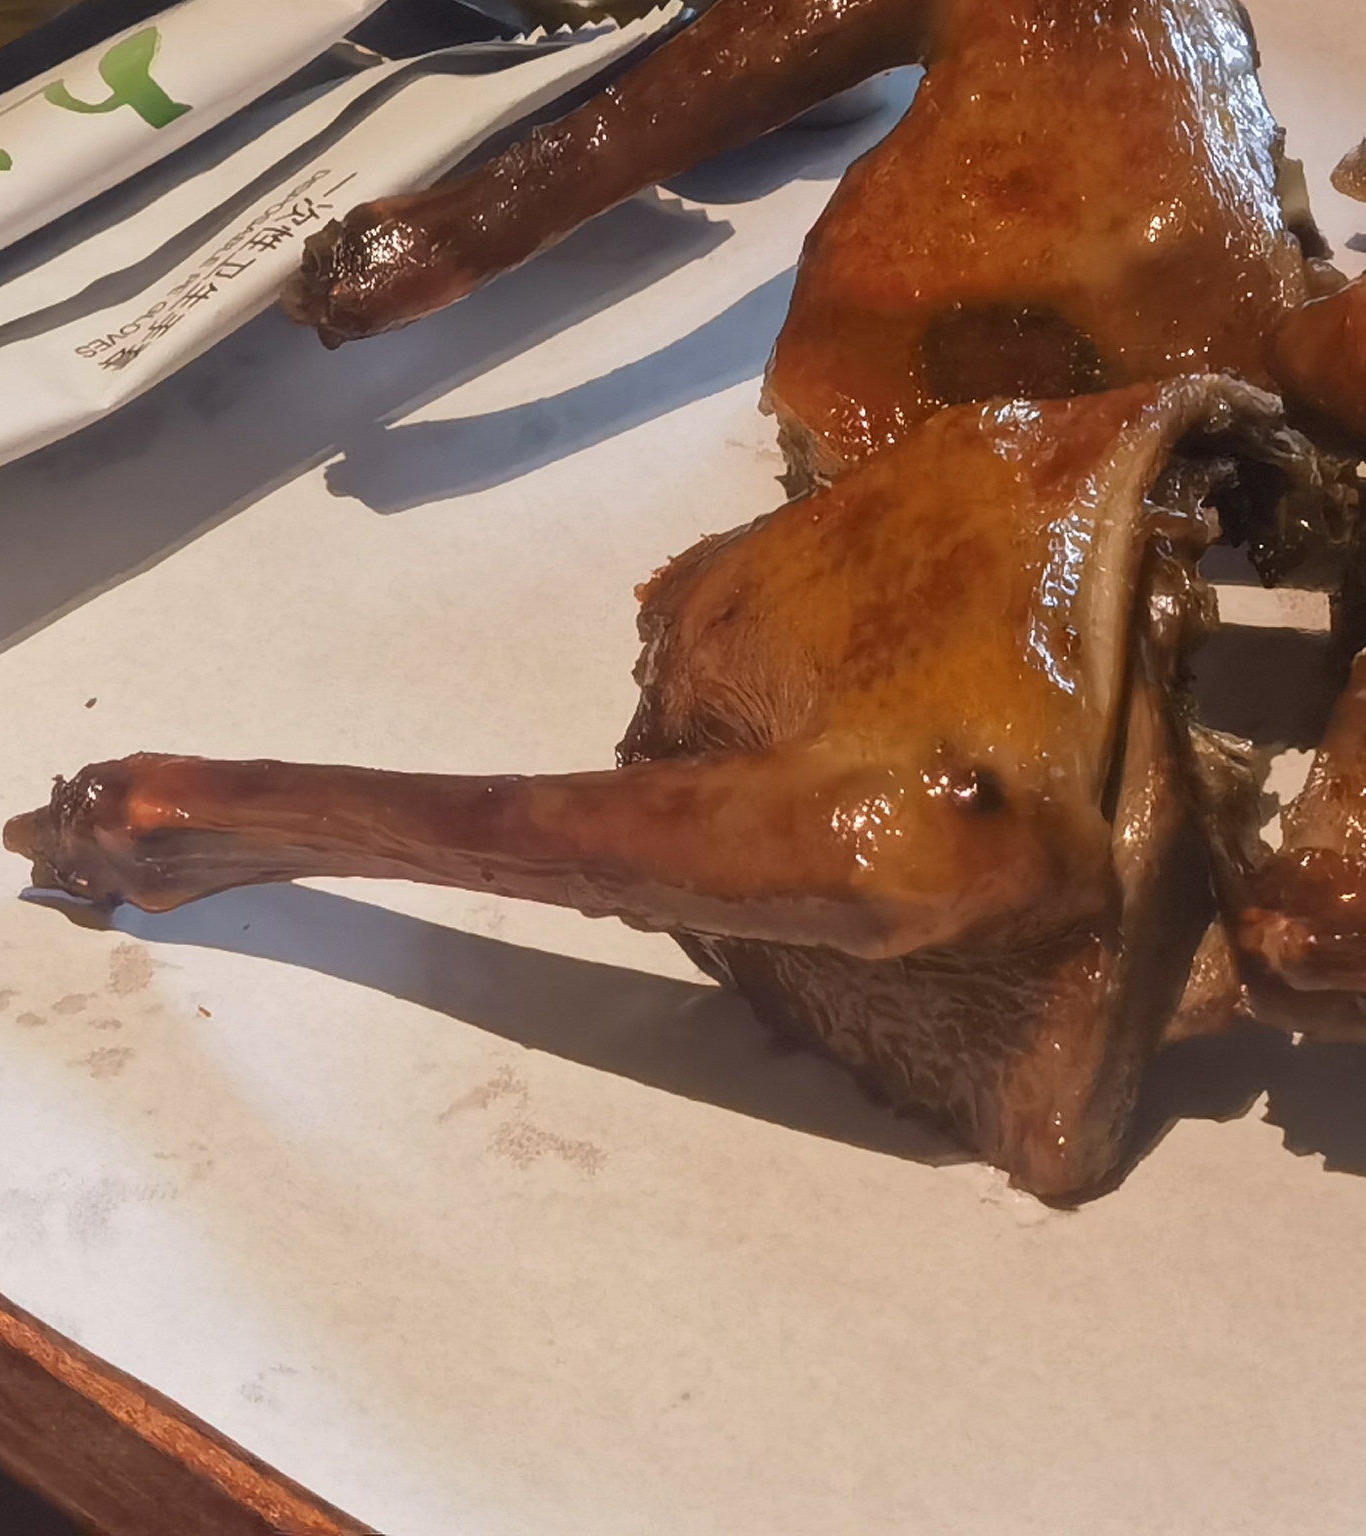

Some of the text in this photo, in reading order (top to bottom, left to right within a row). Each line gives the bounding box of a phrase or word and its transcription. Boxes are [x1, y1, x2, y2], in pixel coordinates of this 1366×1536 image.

[198, 168, 332, 269] DISPOSABLE
[98, 171, 358, 372] 一次性卫生手套
[74, 300, 168, 359] GLOVES
